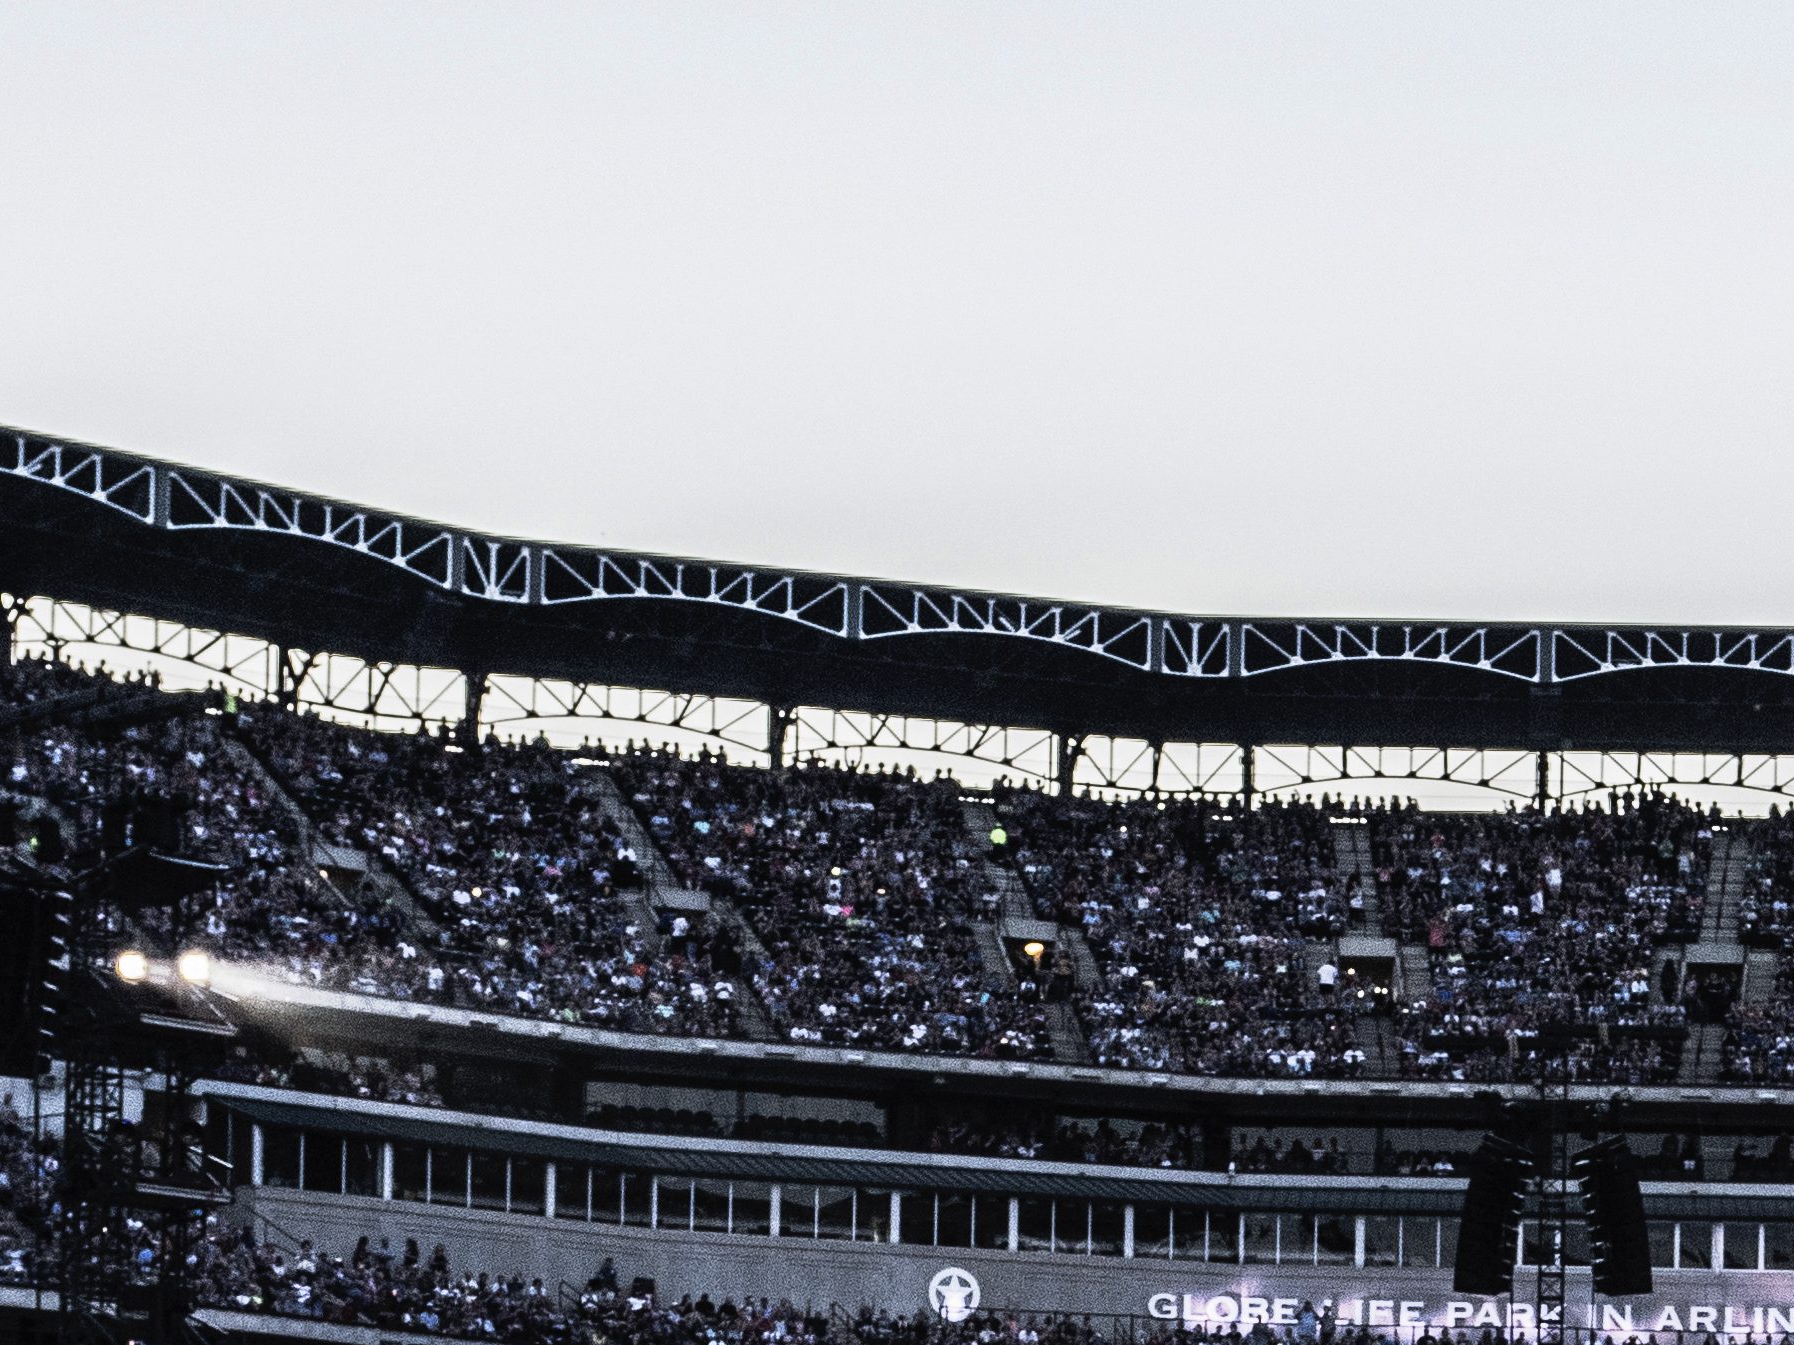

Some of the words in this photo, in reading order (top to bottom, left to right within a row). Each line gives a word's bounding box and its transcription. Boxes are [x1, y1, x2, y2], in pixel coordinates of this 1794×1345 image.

[1147, 1292, 1299, 1326] GLOBE
[1322, 1298, 1426, 1327] LIFE
[1445, 1301, 1566, 1329] PARK
[1587, 1304, 1633, 1331] IN
